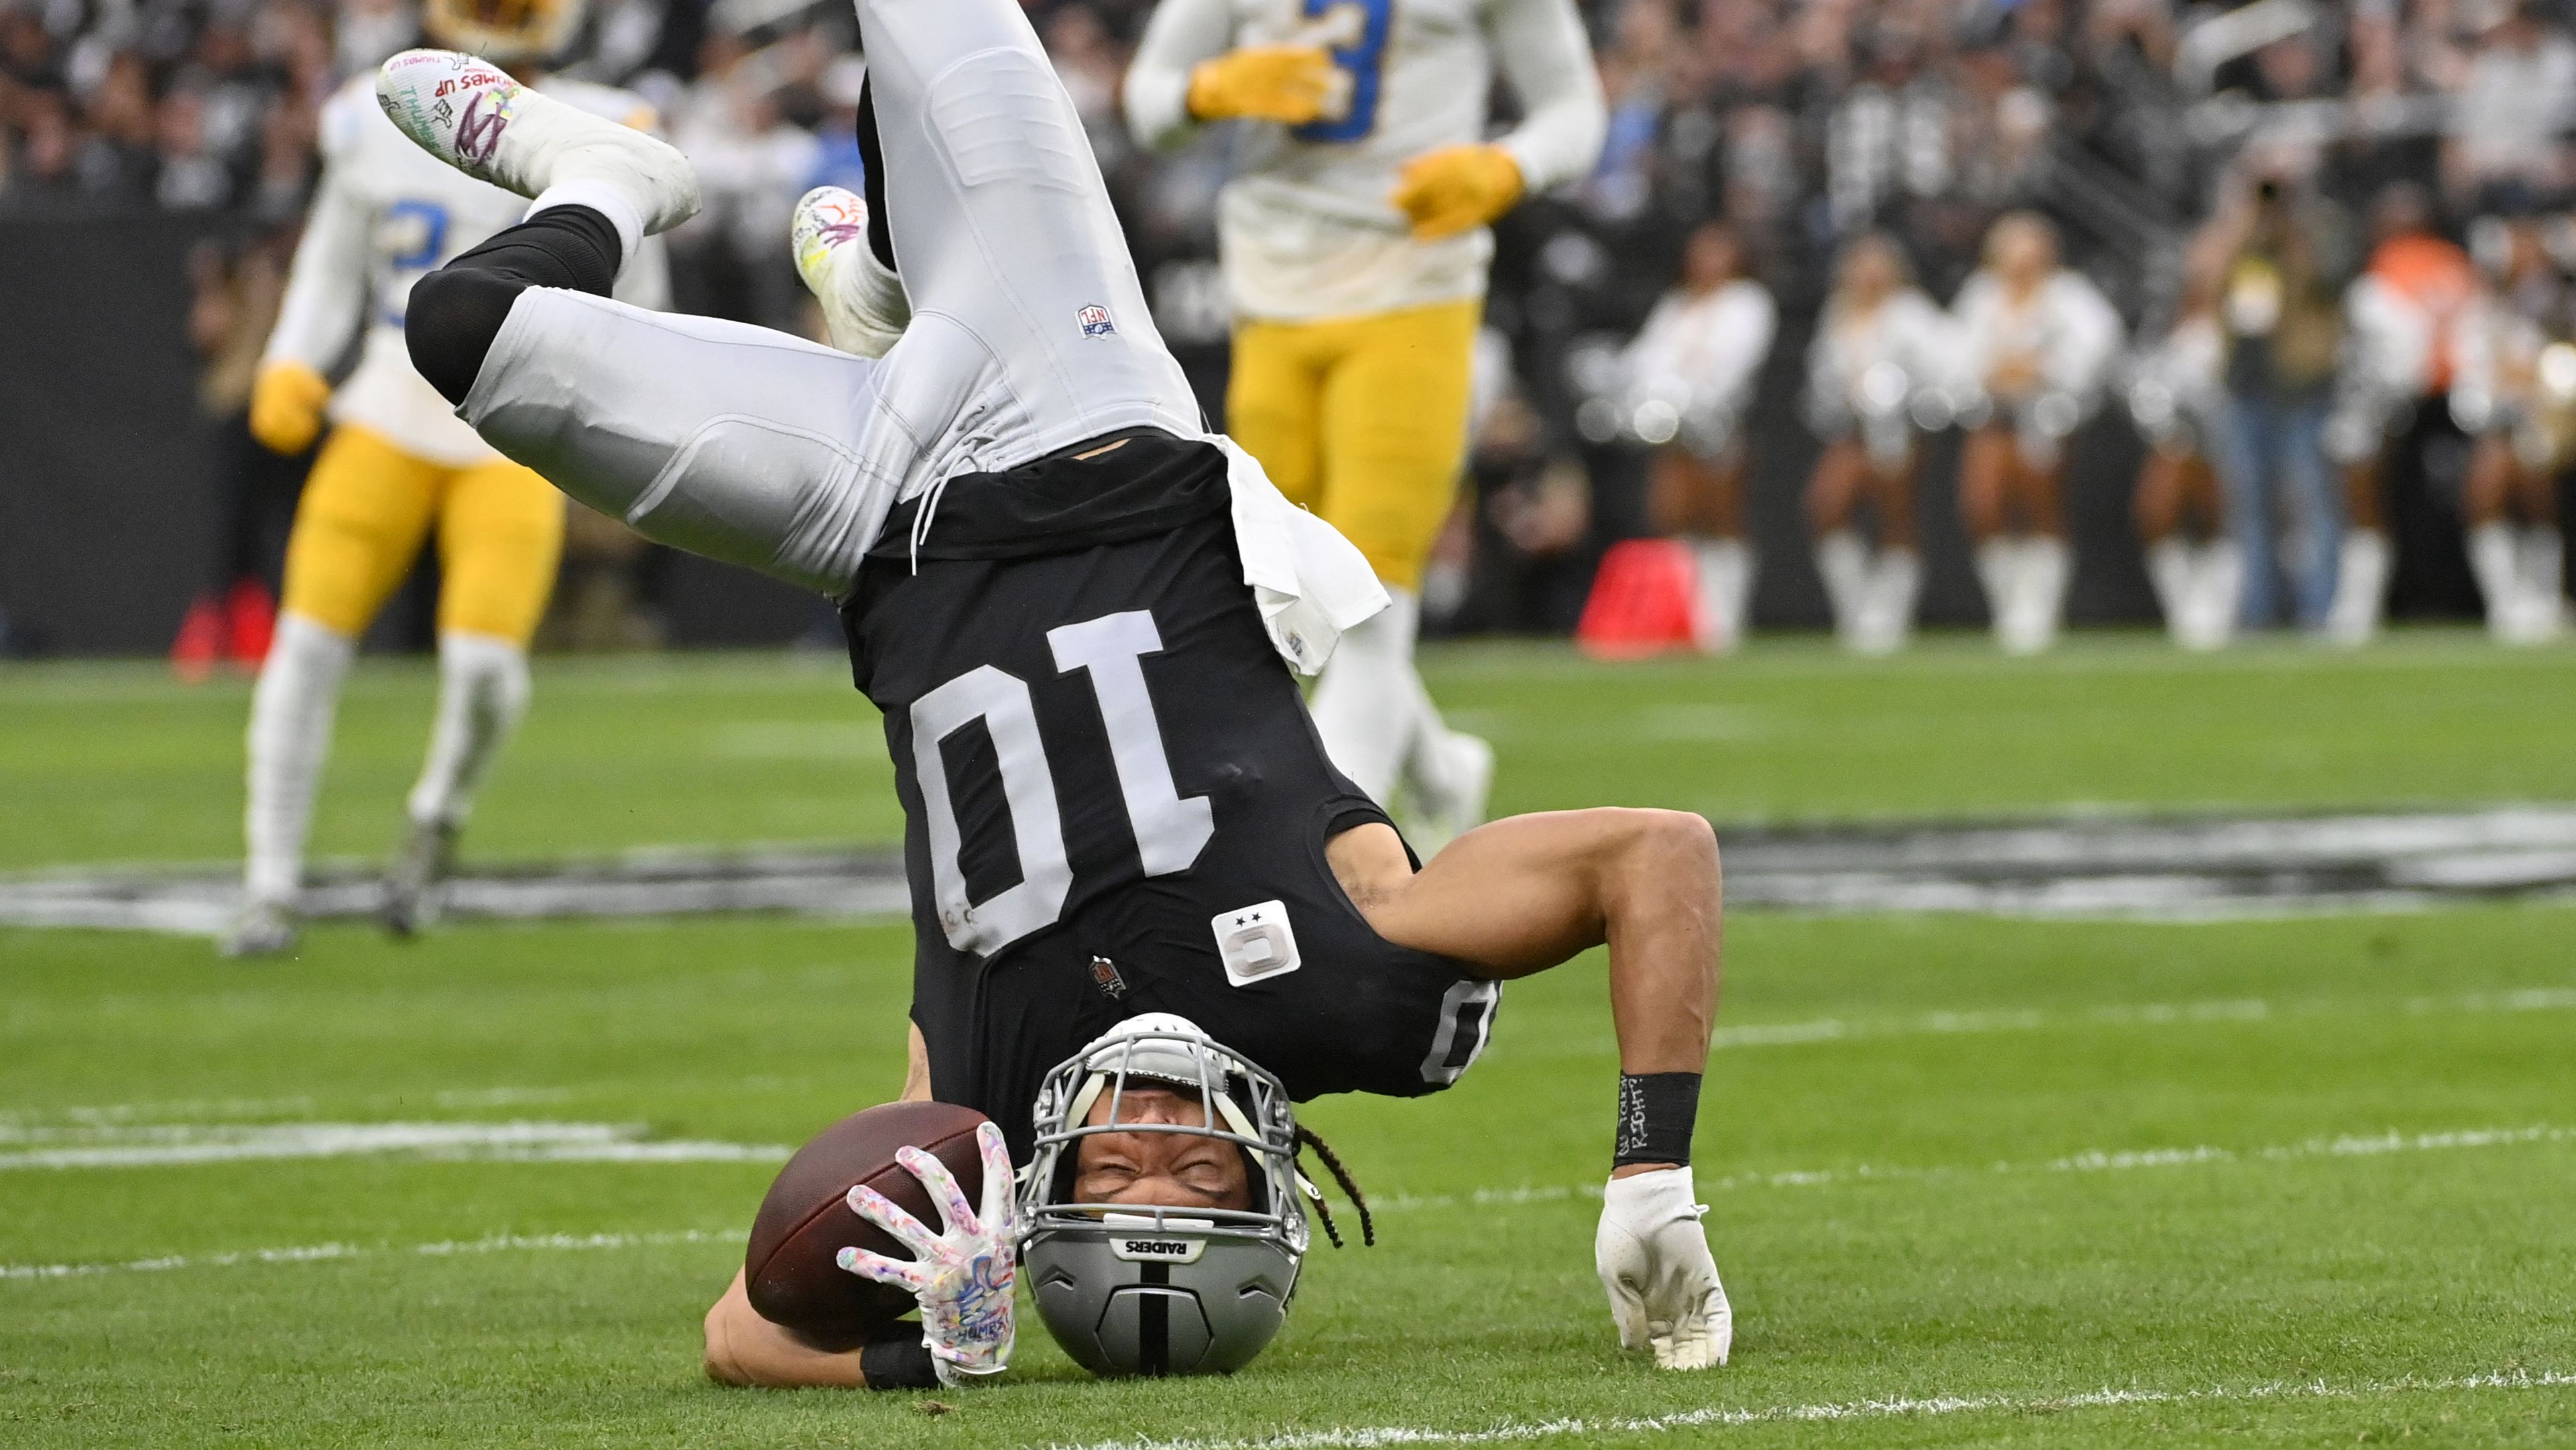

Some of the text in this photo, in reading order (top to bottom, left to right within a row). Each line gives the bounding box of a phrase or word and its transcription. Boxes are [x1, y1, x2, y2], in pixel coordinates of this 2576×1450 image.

[435, 78, 456, 97] UP
[1081, 308, 1107, 324] NFL
[910, 609, 1215, 957] 10
[1419, 979, 1504, 1085] 0
[1125, 1240, 1187, 1255] RAIDERS
